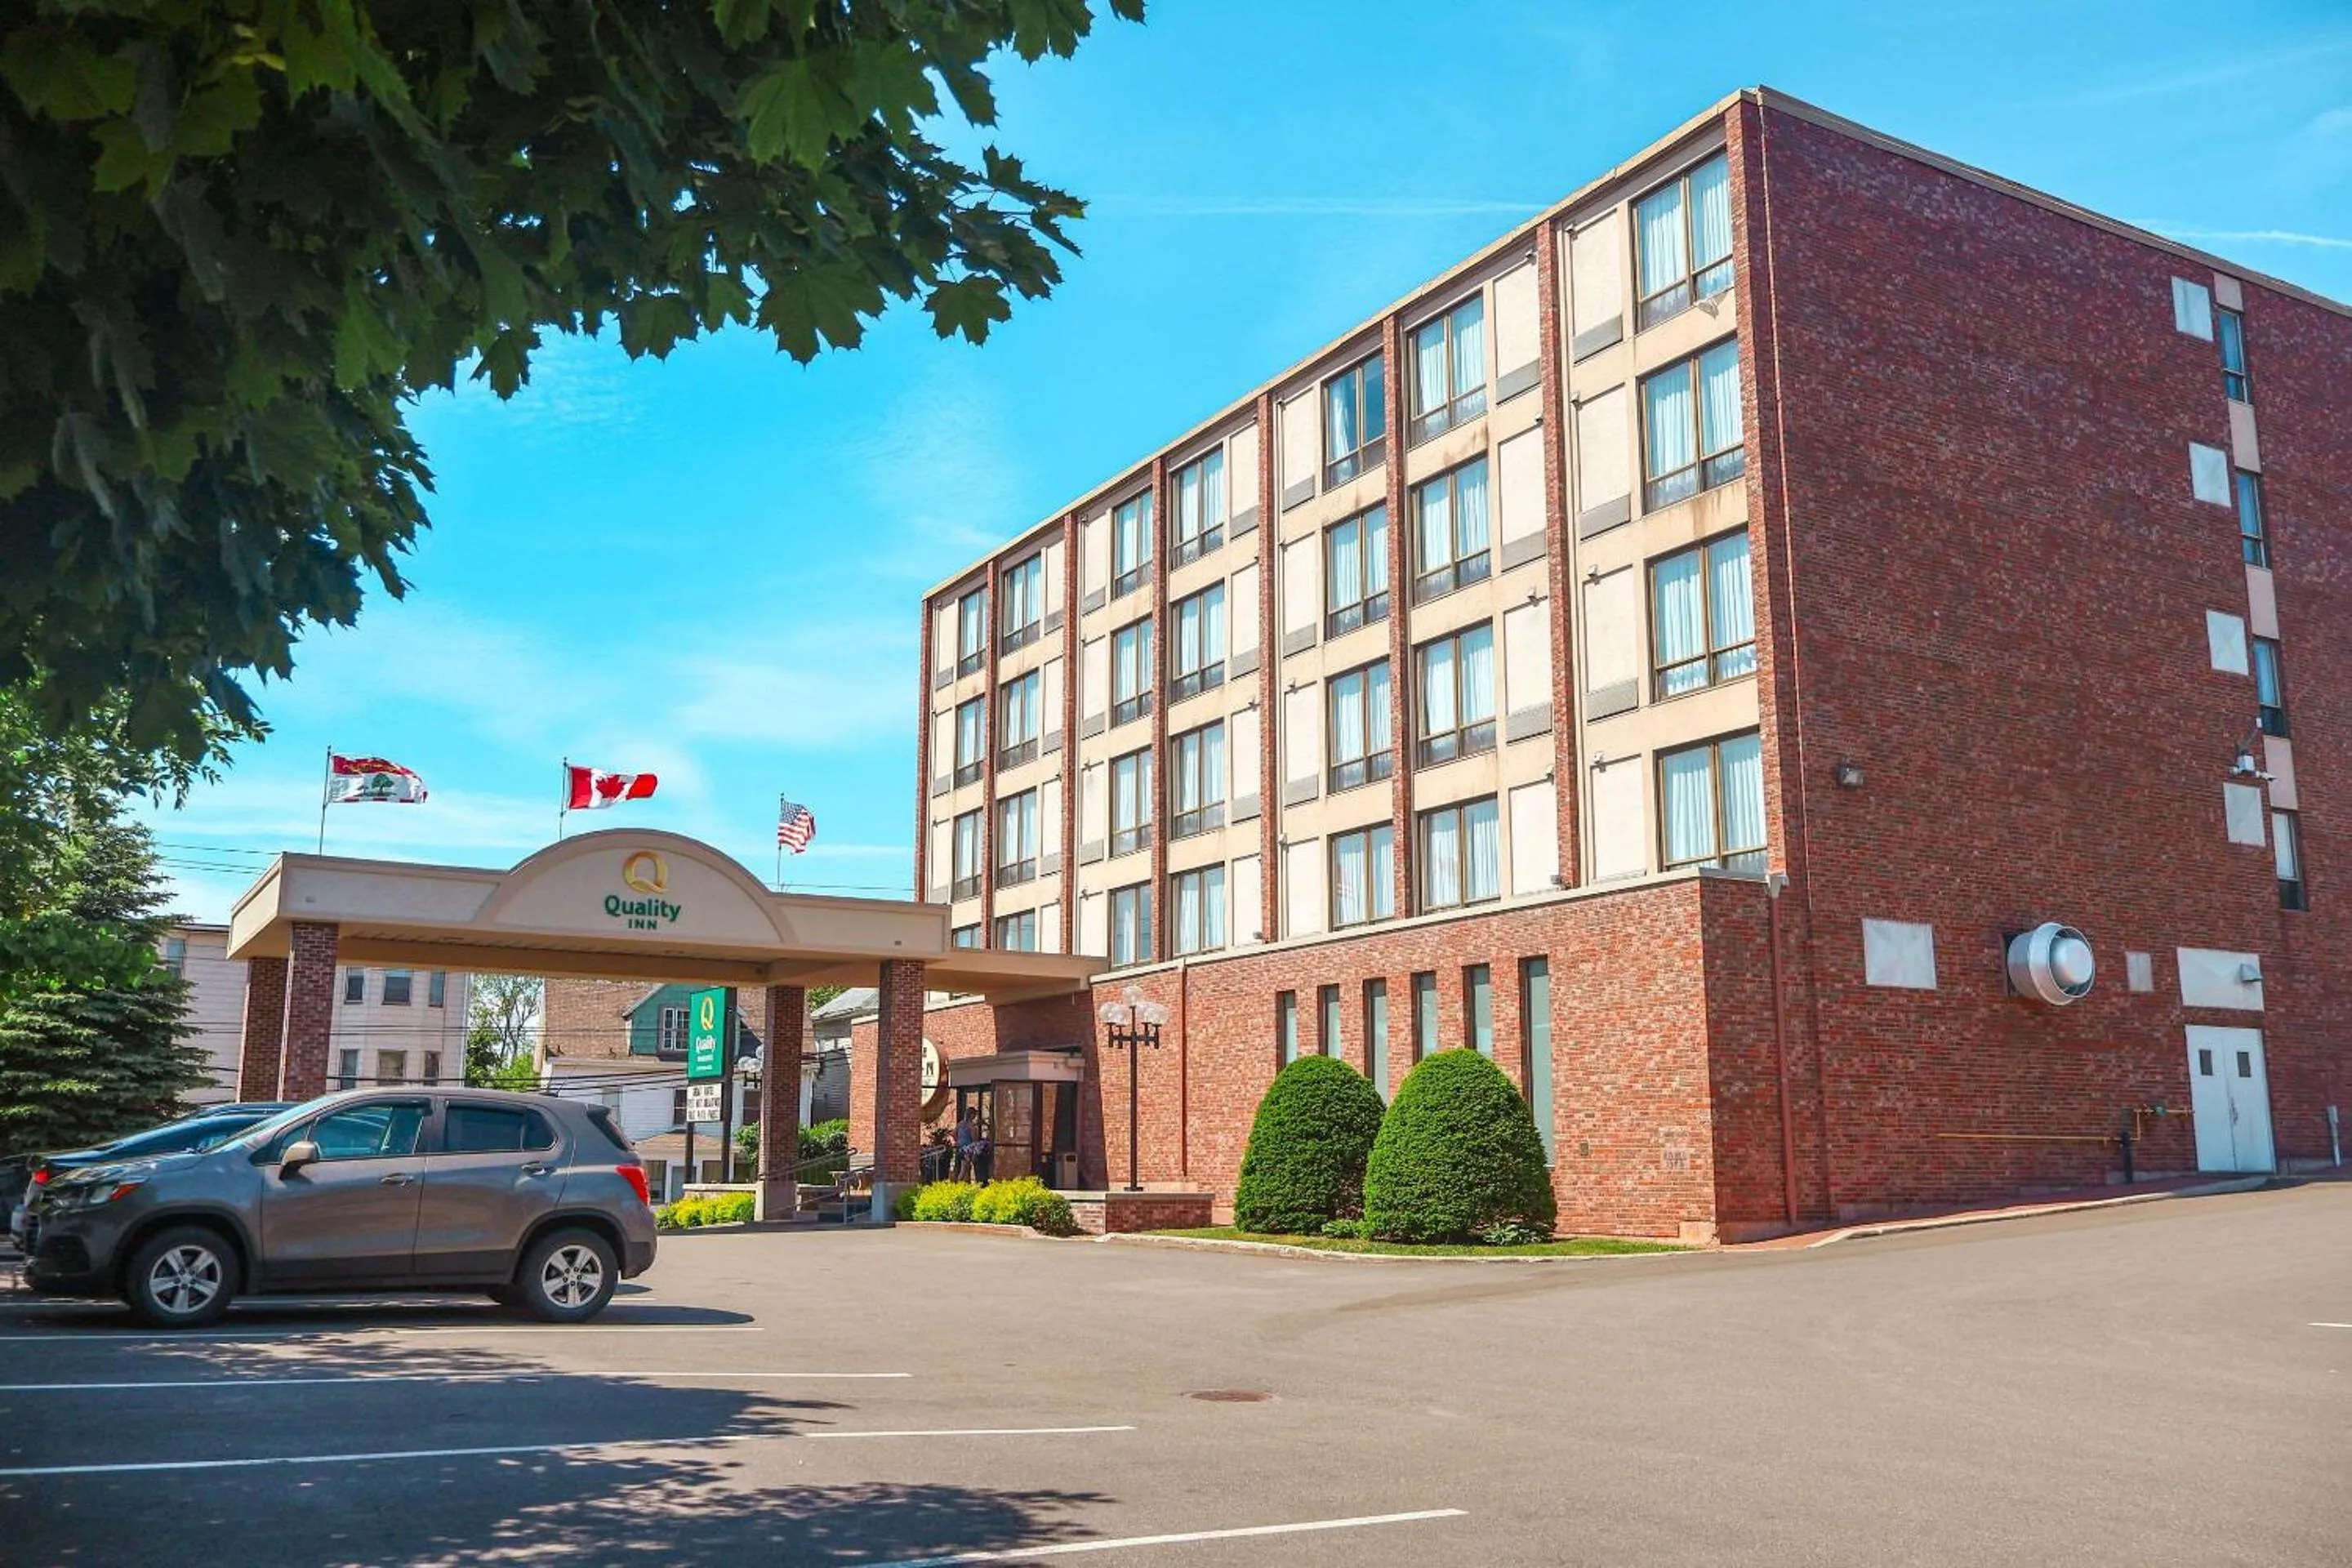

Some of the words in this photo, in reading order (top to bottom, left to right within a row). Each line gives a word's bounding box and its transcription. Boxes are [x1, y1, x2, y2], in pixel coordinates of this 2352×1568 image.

[623, 851, 670, 894] Q
[604, 895, 681, 922] Quality
[628, 919, 657, 930] INN
